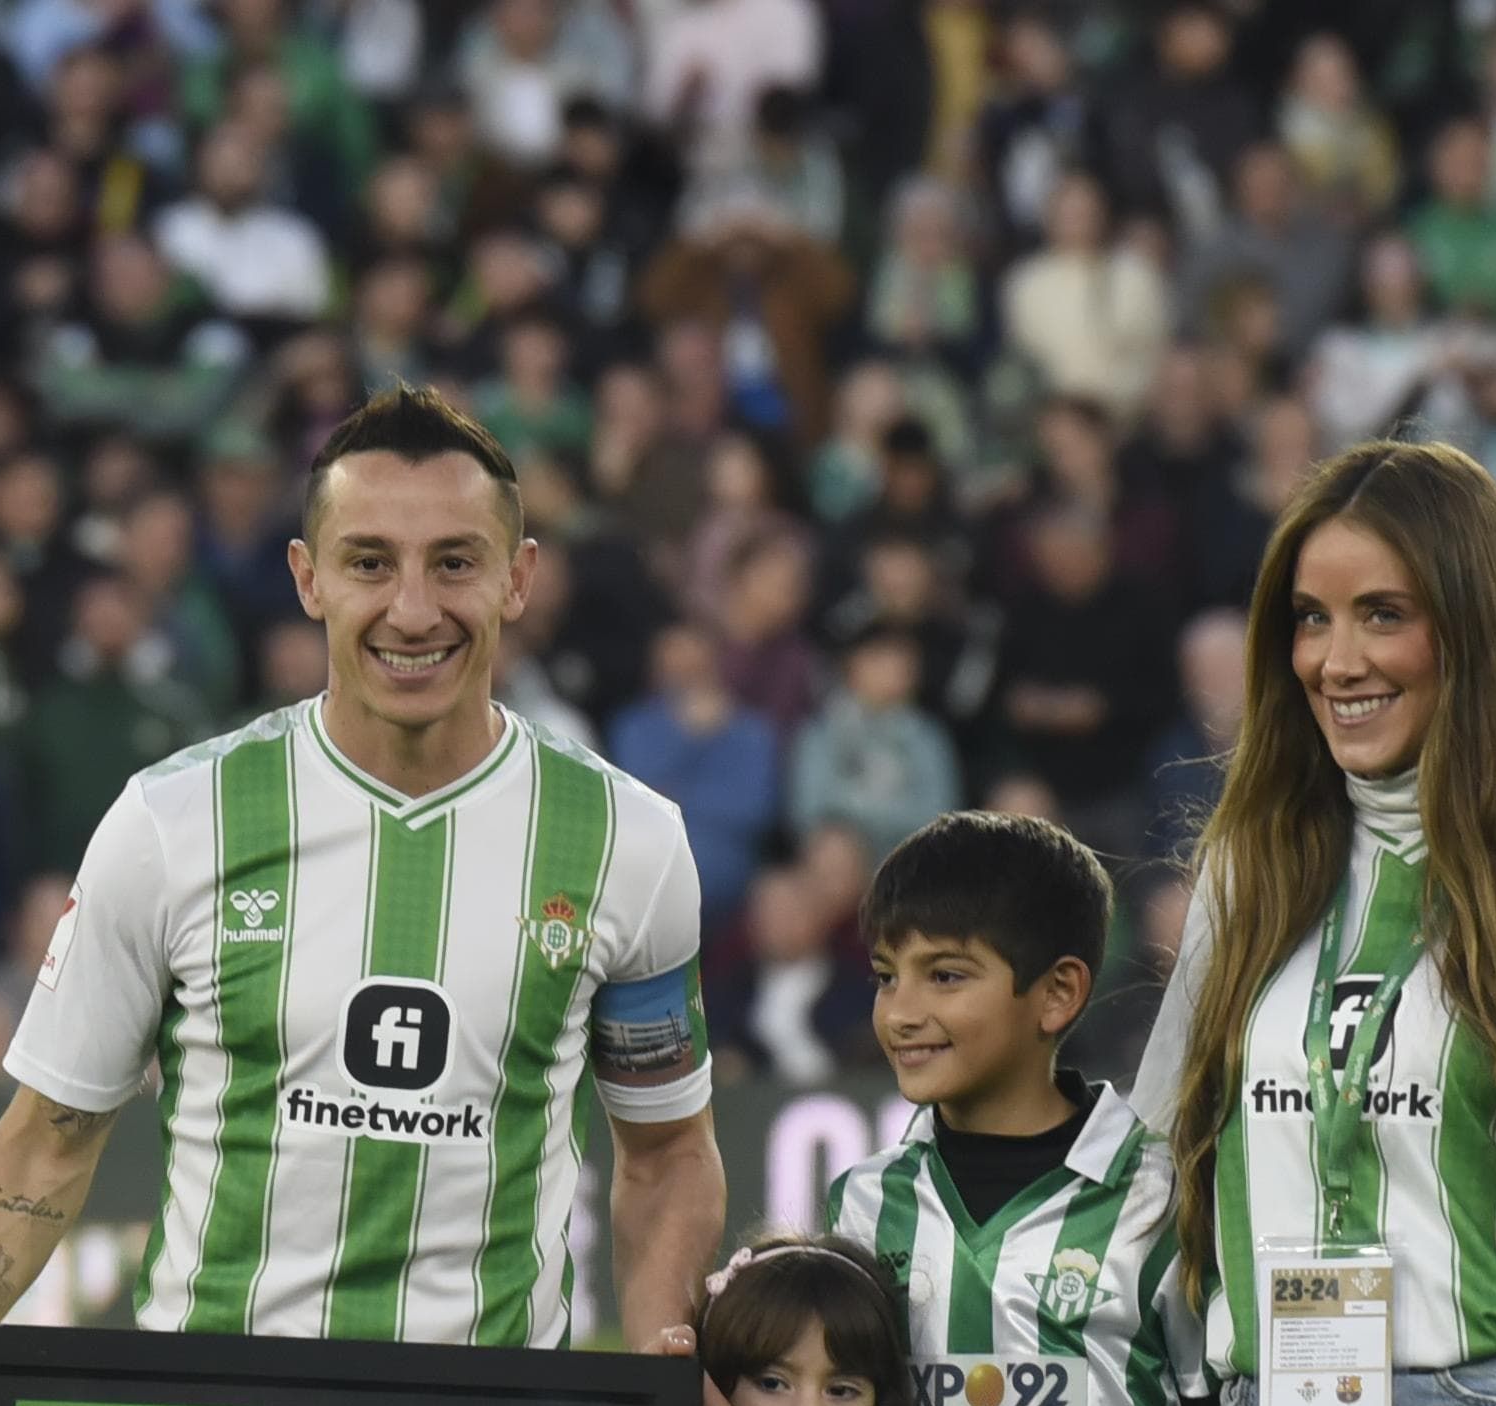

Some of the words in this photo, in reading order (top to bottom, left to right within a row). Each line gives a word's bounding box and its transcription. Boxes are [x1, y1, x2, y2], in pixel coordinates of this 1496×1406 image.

[223, 925, 283, 942] hummel
[287, 1088, 484, 1138] finetwork
[1274, 1278, 1340, 1302] 23-24
